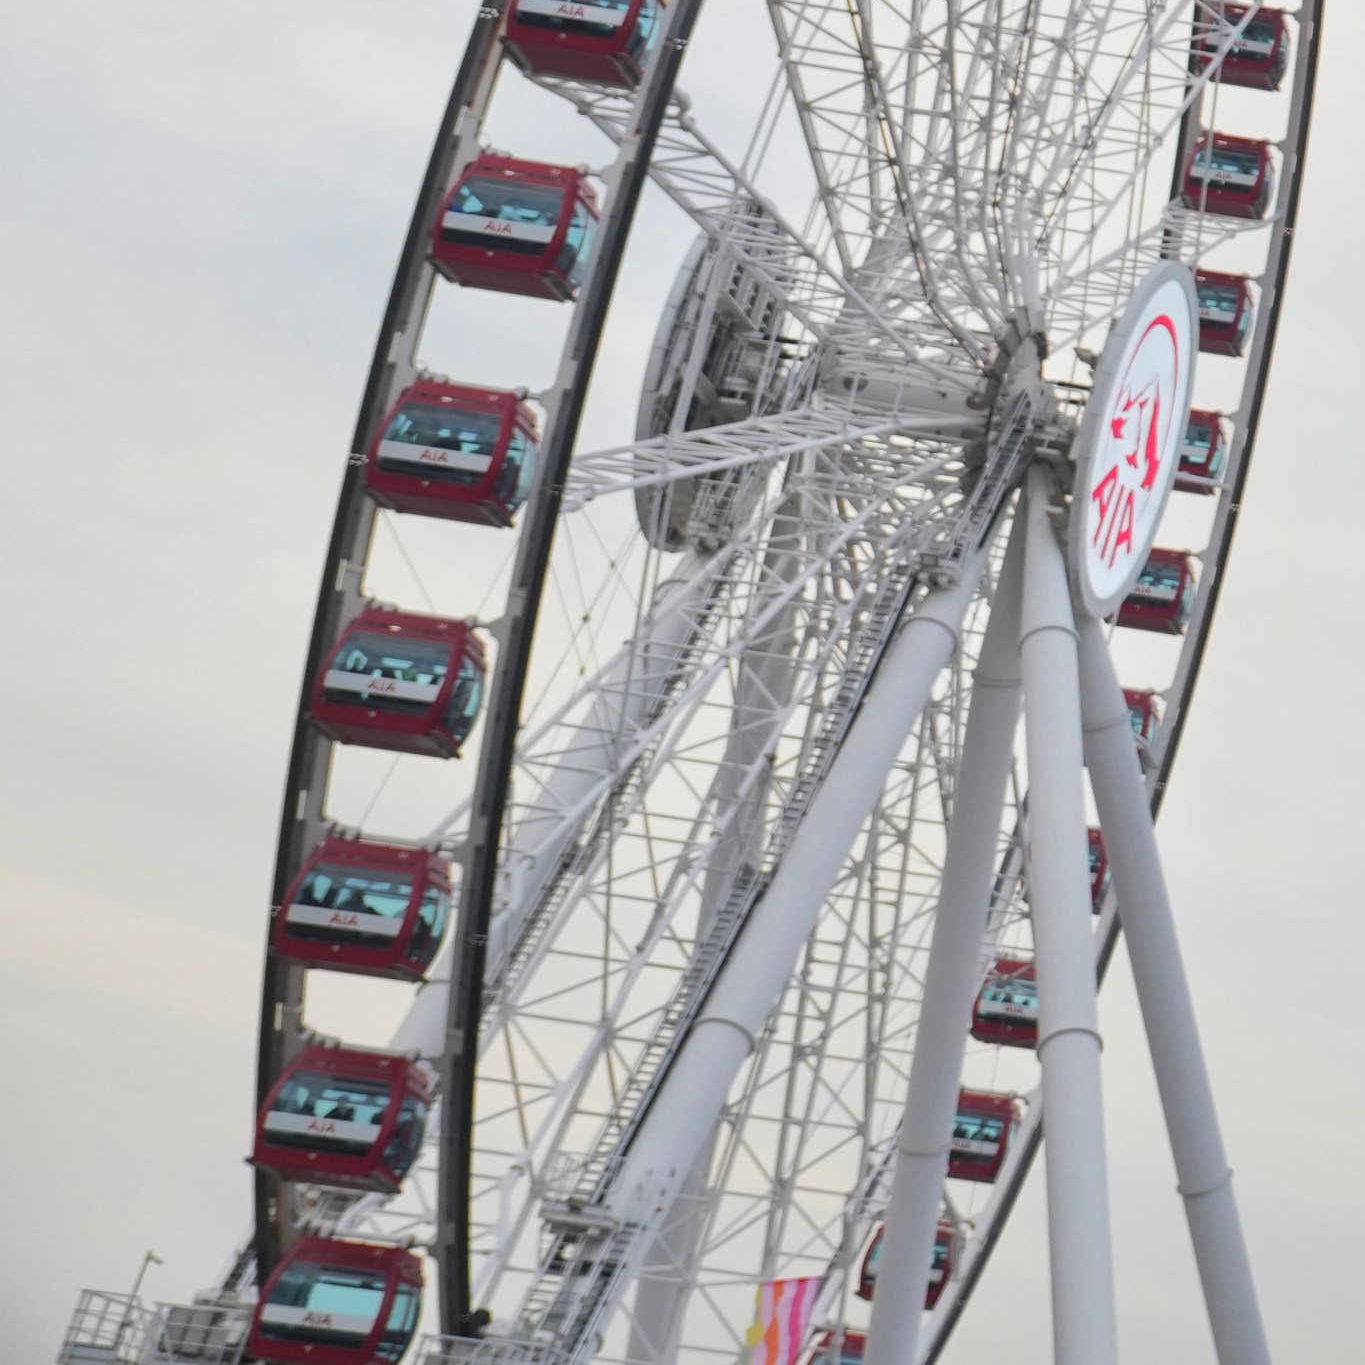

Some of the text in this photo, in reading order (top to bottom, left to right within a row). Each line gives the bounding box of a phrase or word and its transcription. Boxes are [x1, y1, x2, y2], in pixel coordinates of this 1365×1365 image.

[557, 4, 584, 17] AIA
[485, 221, 512, 234] AIA
[420, 450, 448, 463] AIA
[1092, 465, 1134, 569] AIA
[368, 680, 395, 693] AIA
[330, 913, 358, 927] AIA
[308, 1121, 336, 1134] AIA
[303, 1313, 332, 1327] AIA
